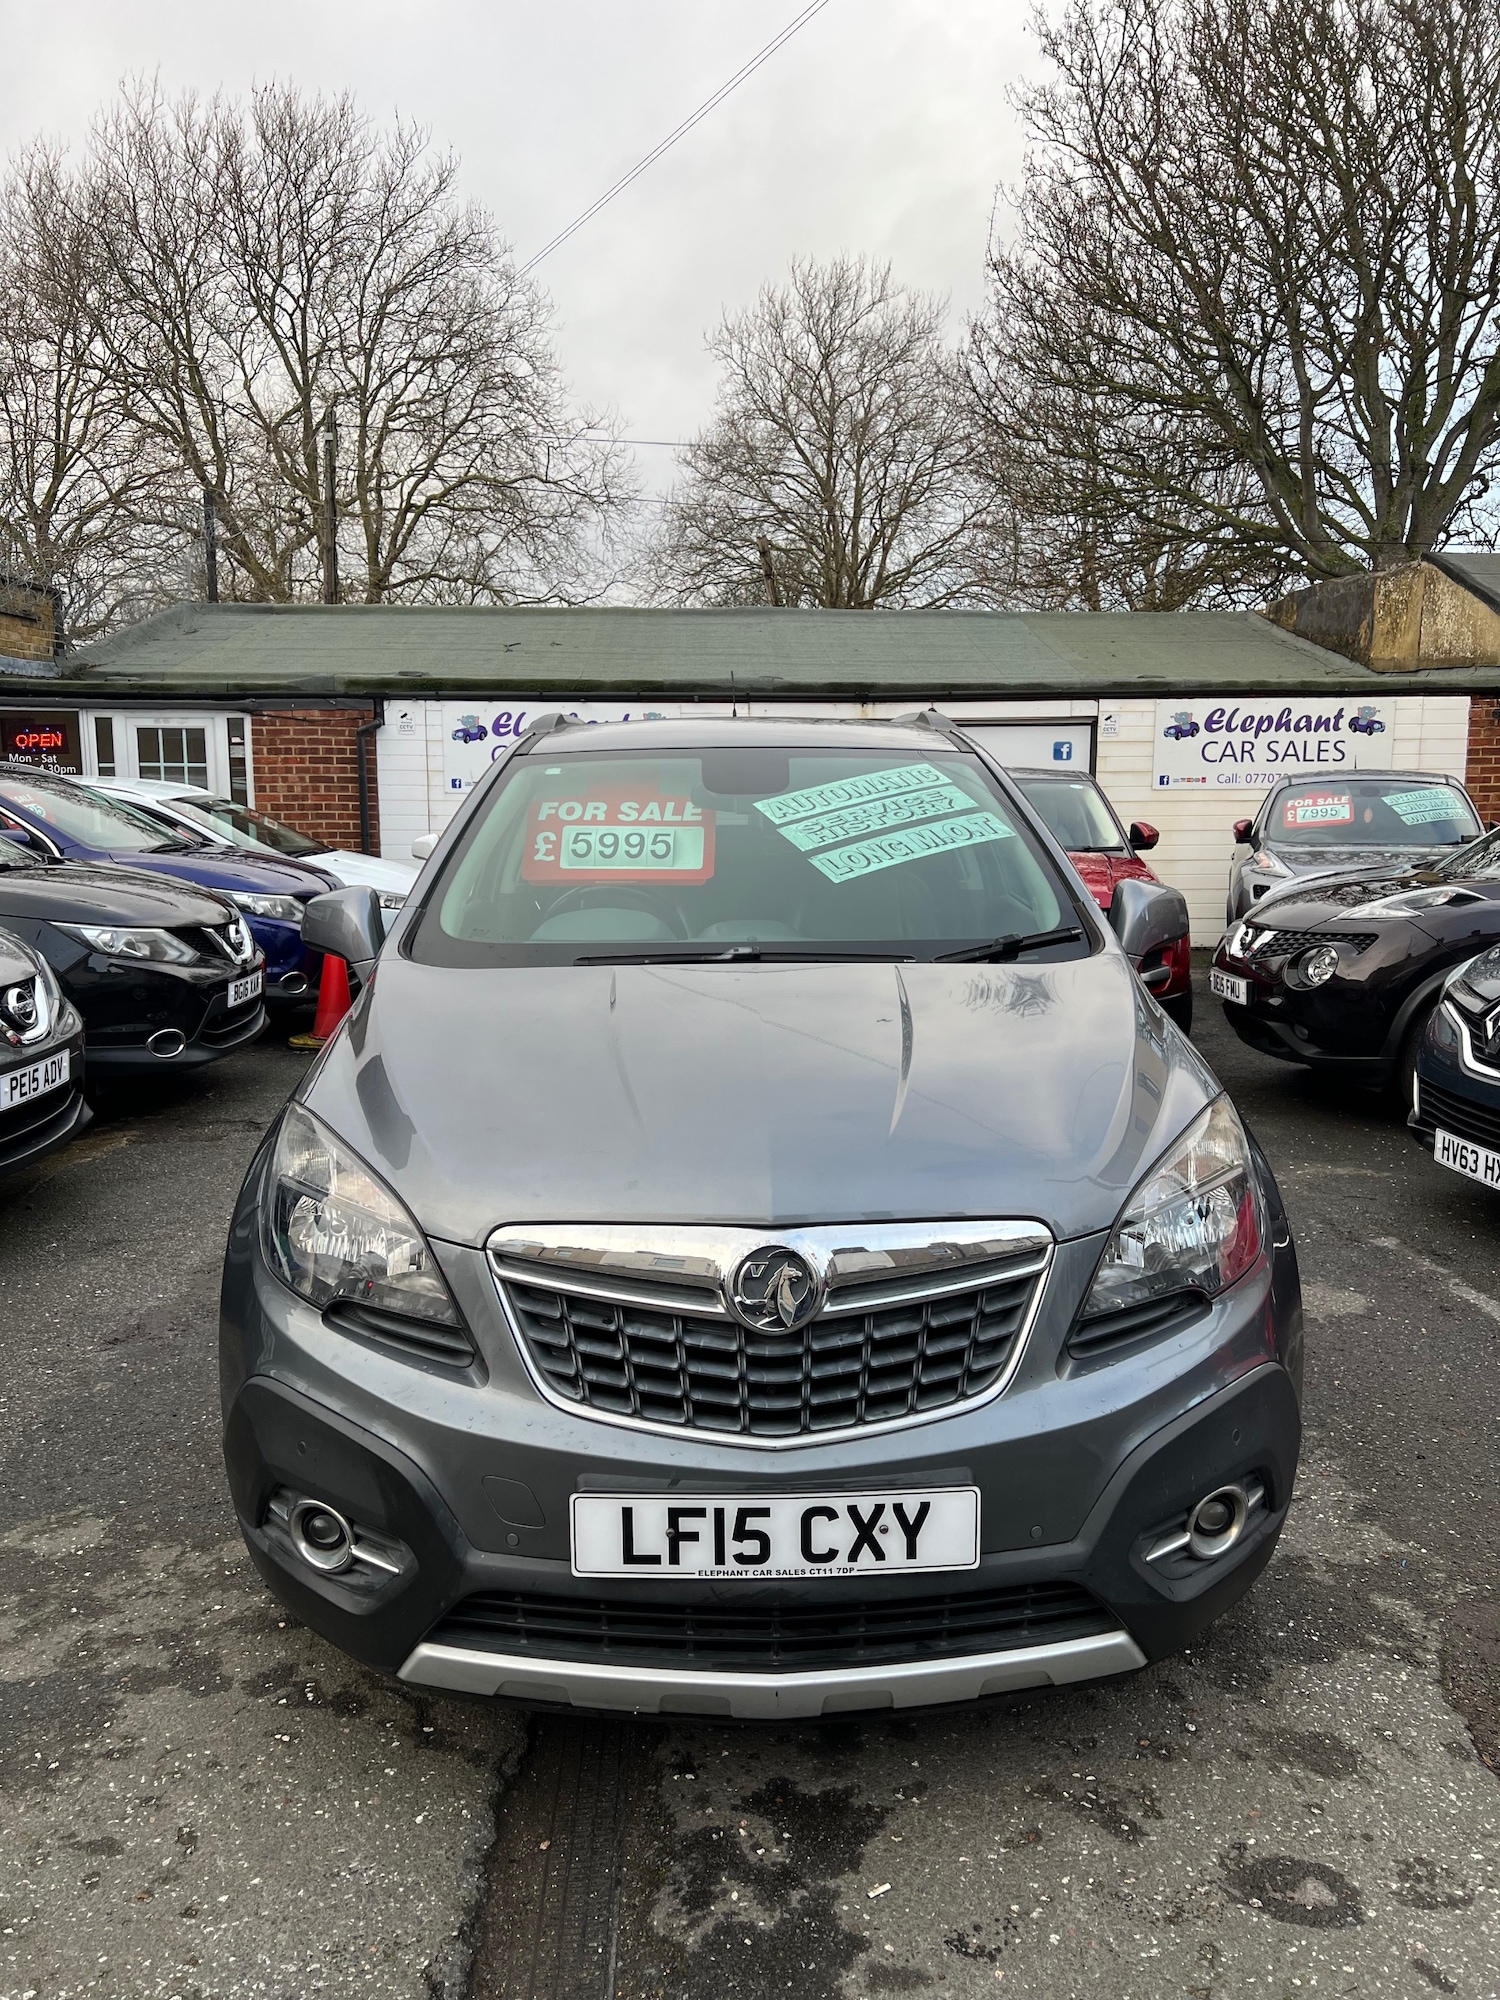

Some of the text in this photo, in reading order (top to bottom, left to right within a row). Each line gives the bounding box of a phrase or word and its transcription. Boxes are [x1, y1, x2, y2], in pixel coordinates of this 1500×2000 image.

[1203, 706, 1345, 739] Elephant
[15, 732, 63, 747] OPEN
[1201, 740, 1346, 763] CAR SALES
[8, 753, 32, 763] Mon
[41, 753, 58, 763] Sat
[766, 767, 941, 819] AUTOMATIC
[1216, 773, 1241, 784] Call:
[1245, 773, 1289, 784] 07707
[537, 801, 703, 822] FOR SALE
[797, 790, 950, 834] SERVICE
[1286, 795, 1350, 808] FOR SALE
[1286, 806, 1338, 822] £ 7995
[805, 797, 956, 844] HISTORY
[533, 831, 672, 862] £ 5995
[820, 838, 915, 877] LONG
[10, 1067, 39, 1102] PE15
[43, 1056, 63, 1088] ADY
[1441, 1136, 1479, 1174] HV63
[621, 1501, 931, 1565] LF15 CXY
[698, 1569, 750, 1577] ELEPHANT
[775, 1568, 806, 1576] SALES
[836, 1567, 855, 1575] 7DP
